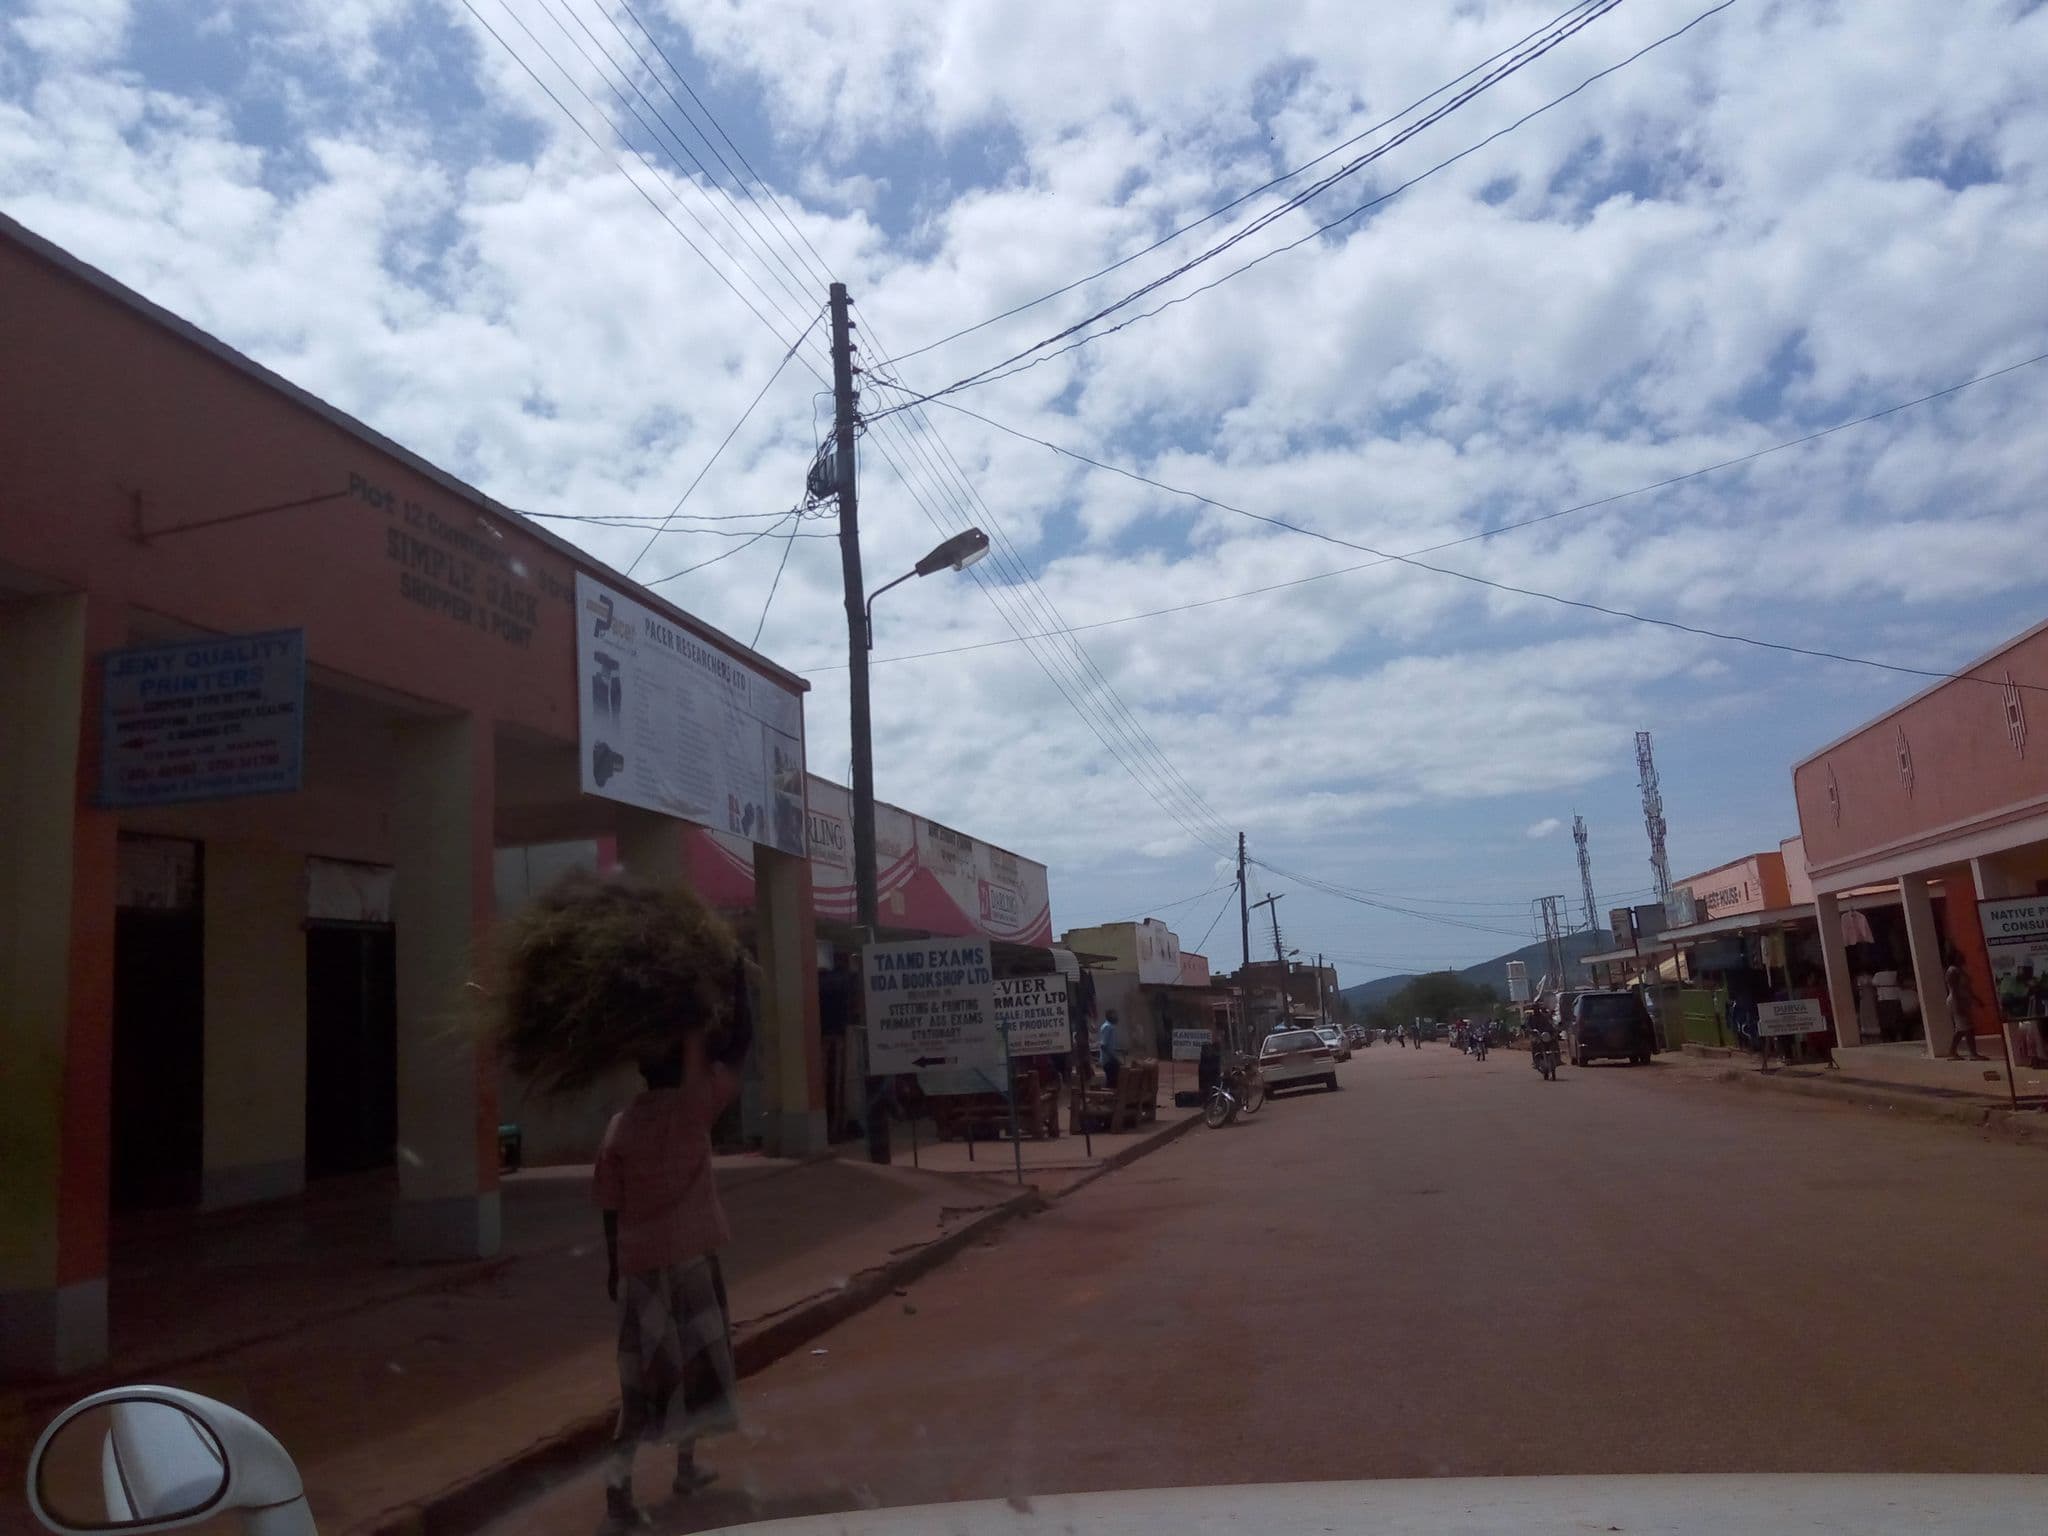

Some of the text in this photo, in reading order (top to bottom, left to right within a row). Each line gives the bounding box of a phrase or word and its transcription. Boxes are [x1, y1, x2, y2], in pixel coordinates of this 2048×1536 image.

[404, 500, 425, 530] 12
[386, 526, 478, 595] SIMPLE
[185, 640, 290, 669] QUALITY
[645, 618, 674, 649] PACER
[675, 635, 731, 683] RESEARCHERS
[732, 668, 746, 691] LTD
[140, 667, 264, 697] PRINTERS
[1990, 907, 2035, 921] NATIVE
[928, 948, 984, 968] EXAMS
[902, 969, 965, 989] BOOKSHOP
[931, 1001, 939, 1013] &
[1045, 991, 1066, 1004] LTD
[951, 1012, 984, 1026] EXAMS
[1019, 1018, 1065, 1032] PRODUCTS
